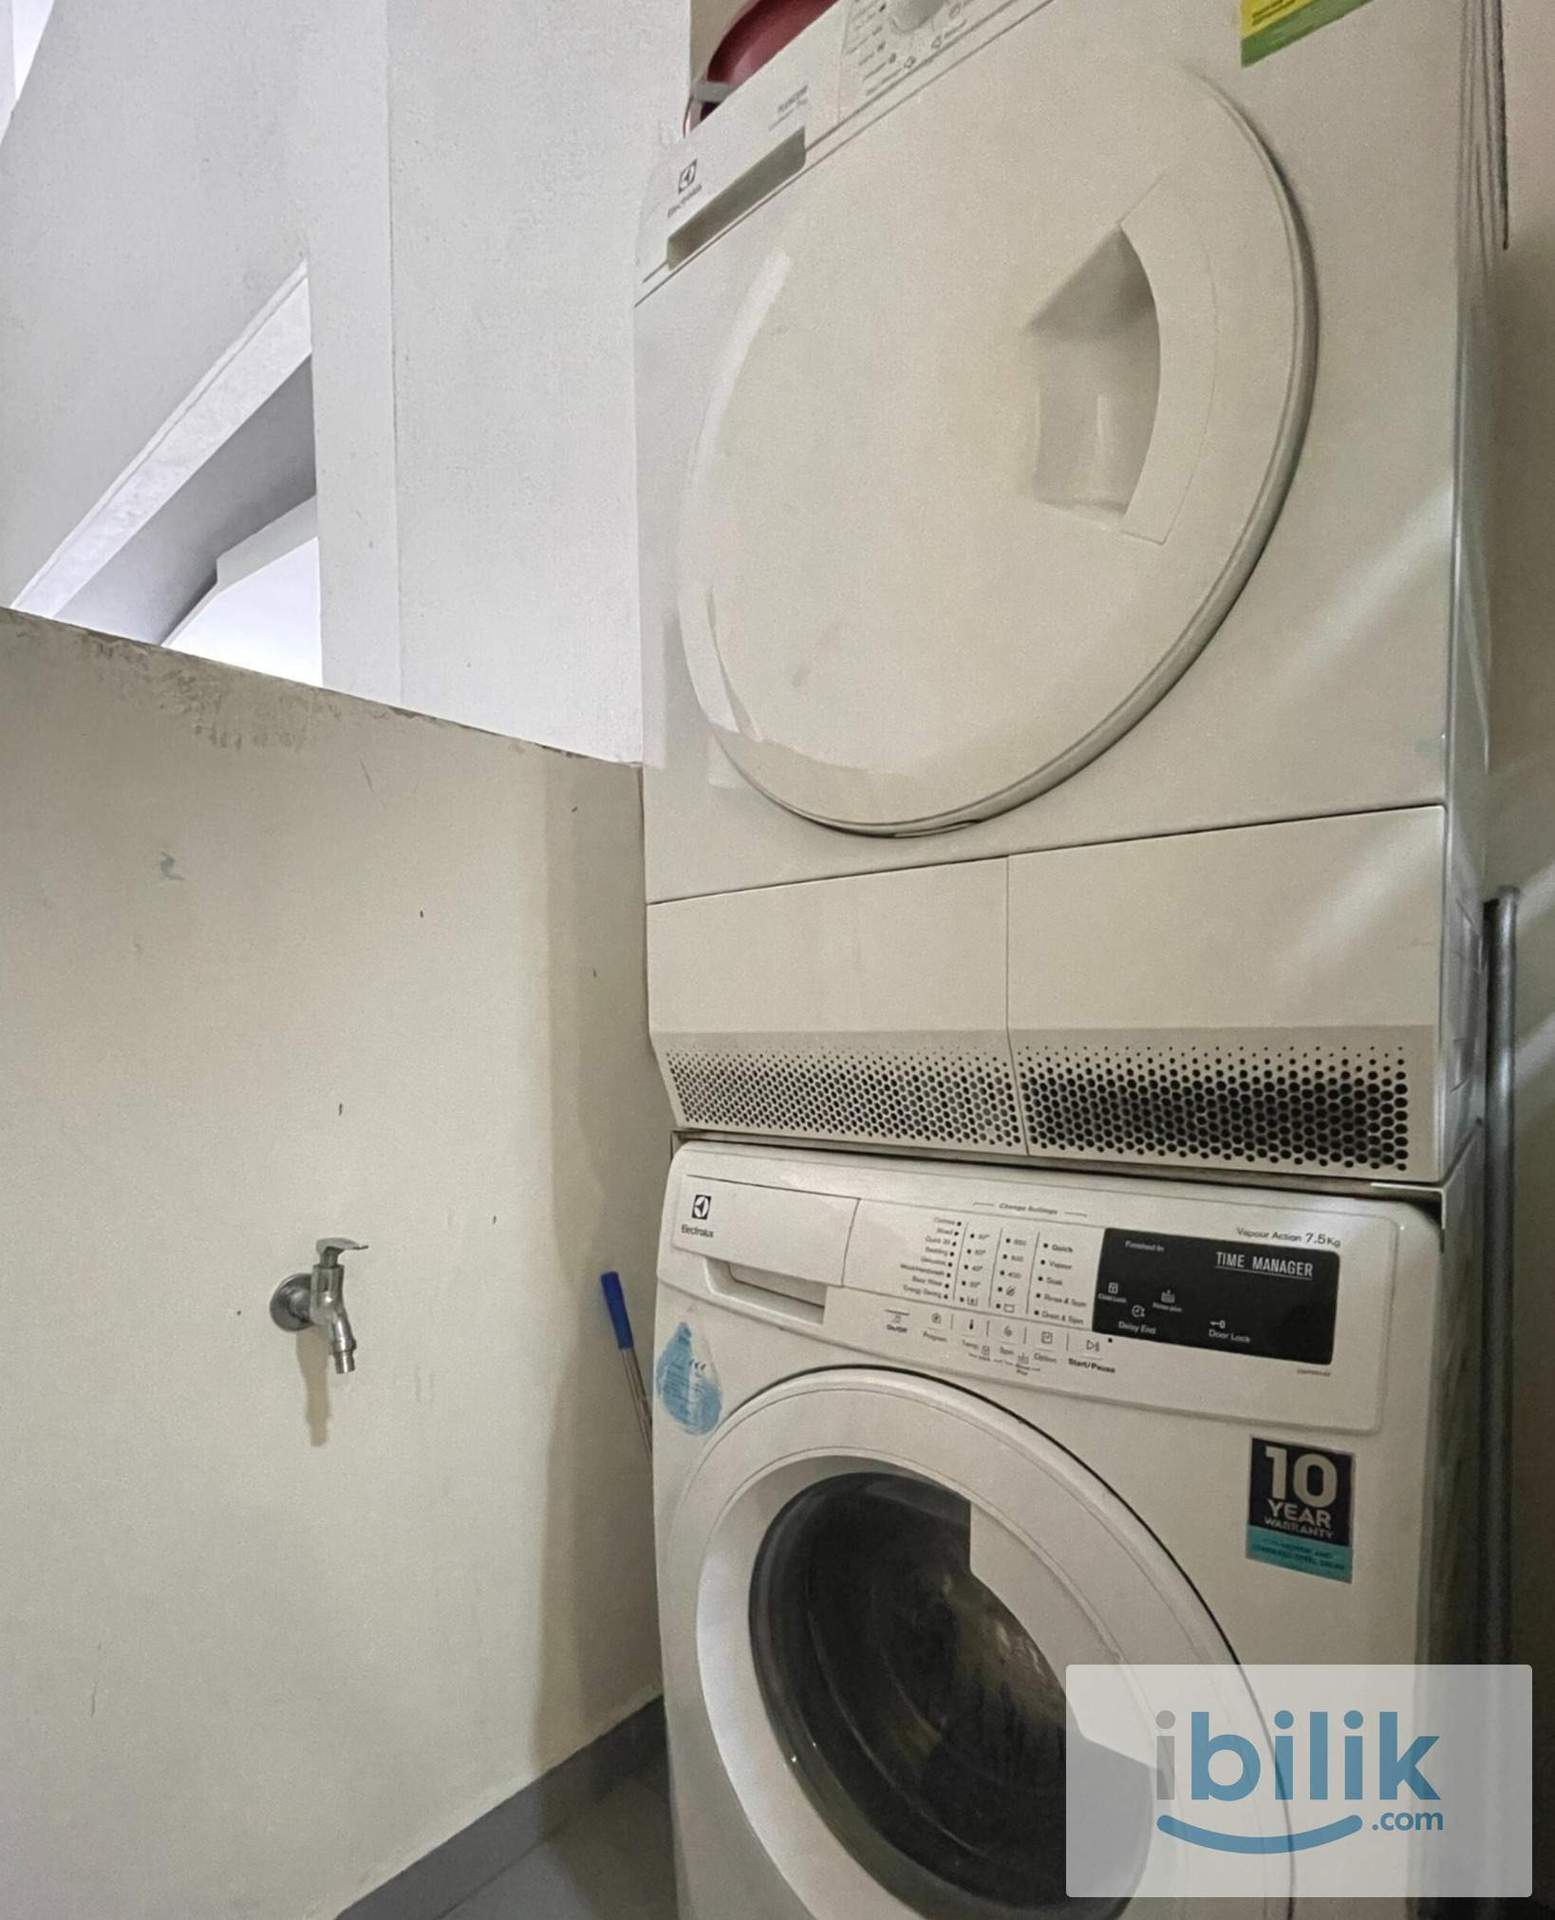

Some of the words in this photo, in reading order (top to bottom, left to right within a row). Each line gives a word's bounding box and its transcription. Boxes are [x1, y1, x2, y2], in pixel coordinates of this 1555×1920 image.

[681, 1223, 714, 1239] Electrolux
[1236, 1227, 1270, 1239] Vapour
[1272, 1231, 1302, 1242] Action
[1051, 1243, 1073, 1253] Quick
[1216, 1251, 1245, 1268] TIME
[1252, 1256, 1313, 1277] MANAGER
[1119, 1321, 1139, 1332] Delay
[1141, 1324, 1157, 1335] End
[1208, 1329, 1229, 1339] Door
[1230, 1333, 1251, 1343] Lock
[1067, 1357, 1116, 1374] Start/Pause
[1265, 1445, 1338, 1508] 10
[1266, 1499, 1332, 1529] YEAR
[1264, 1516, 1334, 1539] WARRANTY
